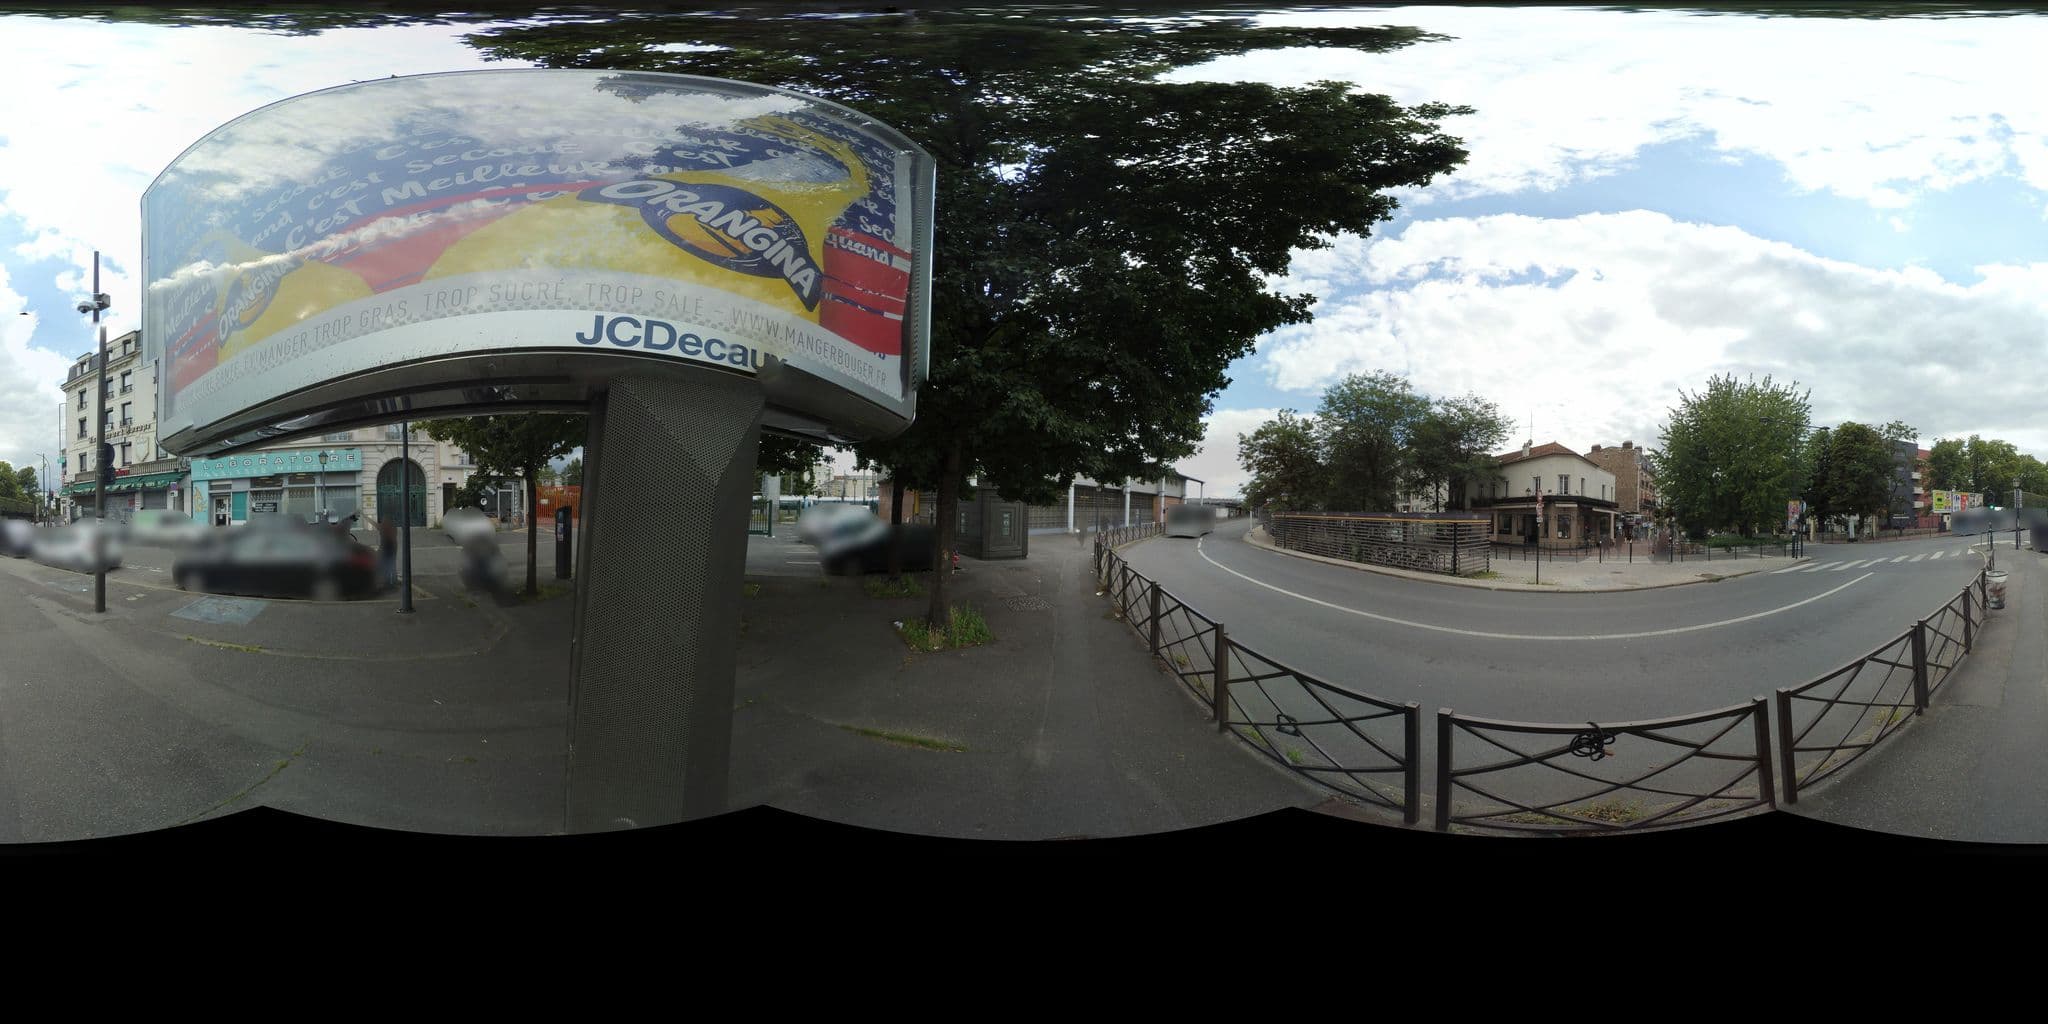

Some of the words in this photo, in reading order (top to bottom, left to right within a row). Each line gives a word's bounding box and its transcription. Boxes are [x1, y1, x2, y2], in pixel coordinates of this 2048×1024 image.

[599, 179, 821, 297] ORANGINA
[219, 261, 294, 341] ORANGINA
[314, 315, 352, 344] TROP
[424, 286, 478, 312] TROP
[586, 282, 643, 305] TROP
[732, 307, 887, 386] WWW.MANGERBOUGER.FR
[202, 453, 355, 470] LABORATORE
